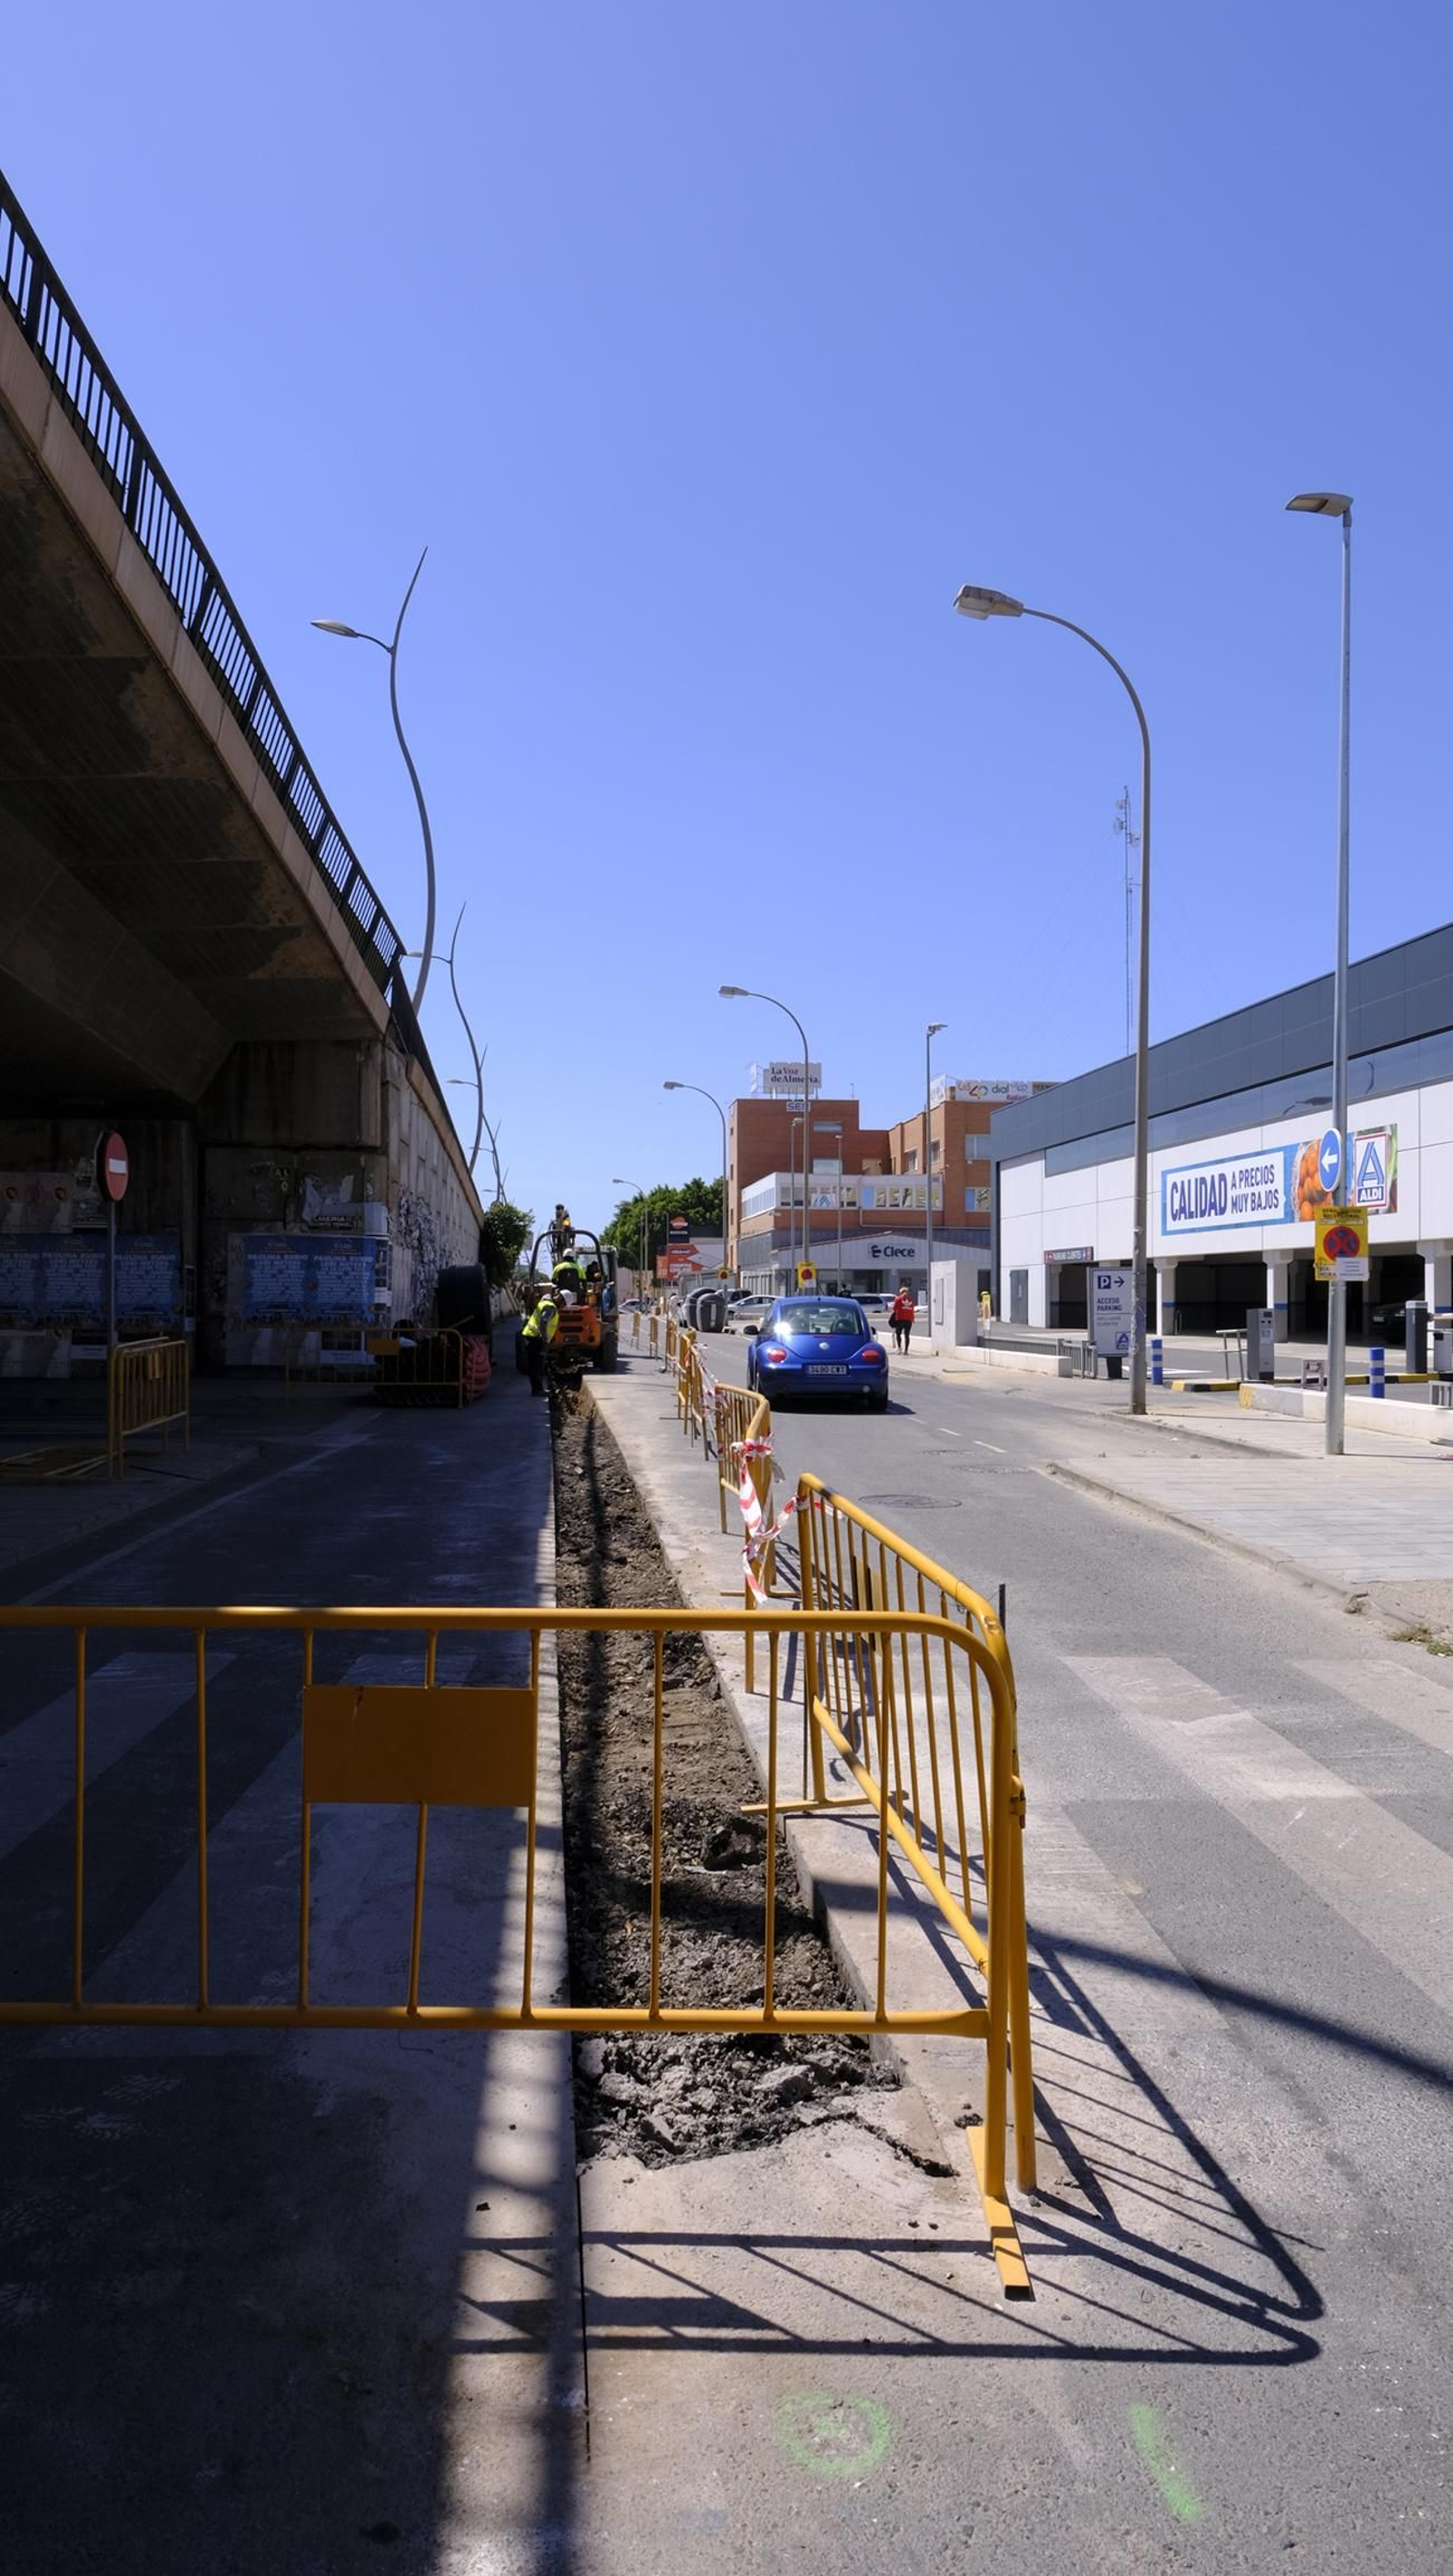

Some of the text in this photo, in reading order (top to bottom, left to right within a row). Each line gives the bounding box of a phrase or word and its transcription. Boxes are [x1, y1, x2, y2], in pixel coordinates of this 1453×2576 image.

[991, 1083, 1010, 1094] dial
[1171, 1163, 1275, 1221] CALIDAD A PRECIOS
[1359, 1187, 1382, 1201] ALDI
[1231, 1189, 1280, 1215] MUY BAJOS
[884, 1246, 915, 1258] Clece
